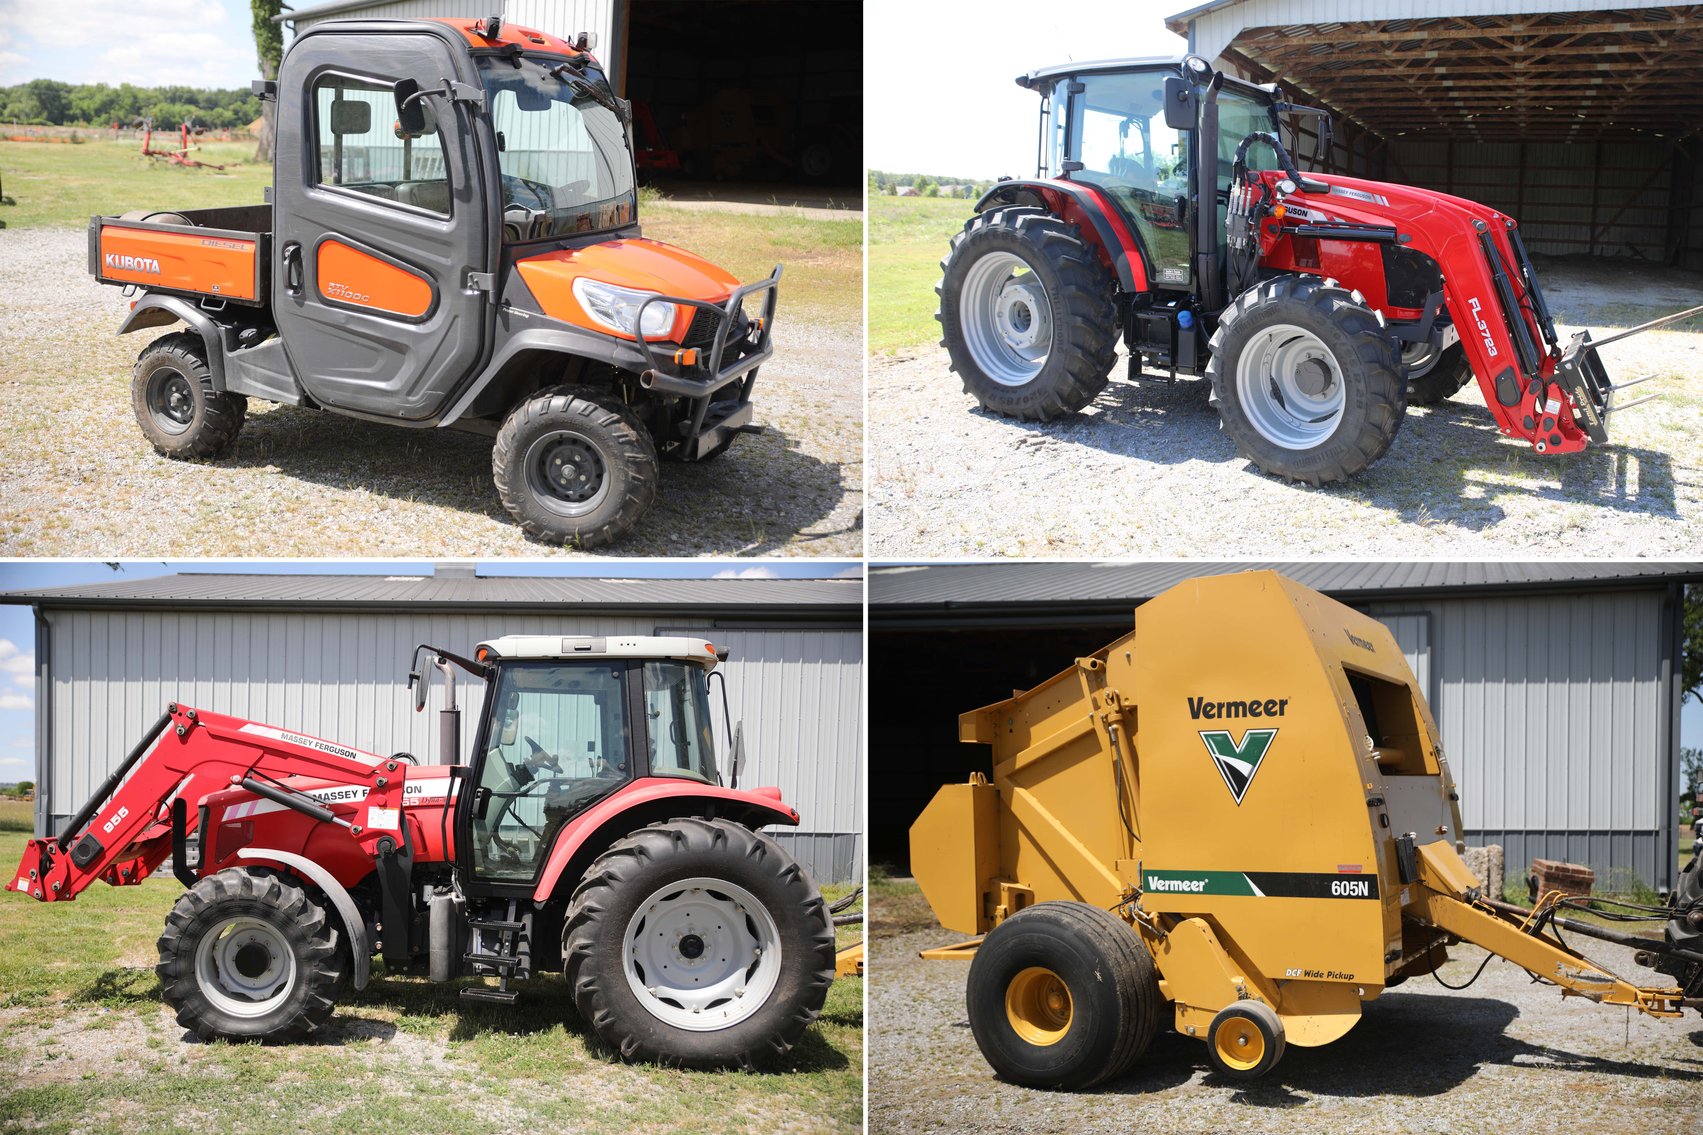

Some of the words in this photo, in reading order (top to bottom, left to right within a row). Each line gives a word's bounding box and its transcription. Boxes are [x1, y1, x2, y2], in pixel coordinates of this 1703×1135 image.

[105, 253, 161, 274] KUBOTA
[1187, 696, 1289, 720] Vermeer
[281, 732, 314, 747] MASSEY
[314, 741, 357, 760] FERGUSON
[312, 790, 358, 803] MASSEY
[103, 806, 129, 834] 955
[1148, 875, 1206, 892] Vermeer
[1331, 880, 1369, 897] 605N
[1285, 968, 1303, 977] DCF
[1304, 969, 1325, 978] Wide
[1326, 970, 1355, 981] Pickup
